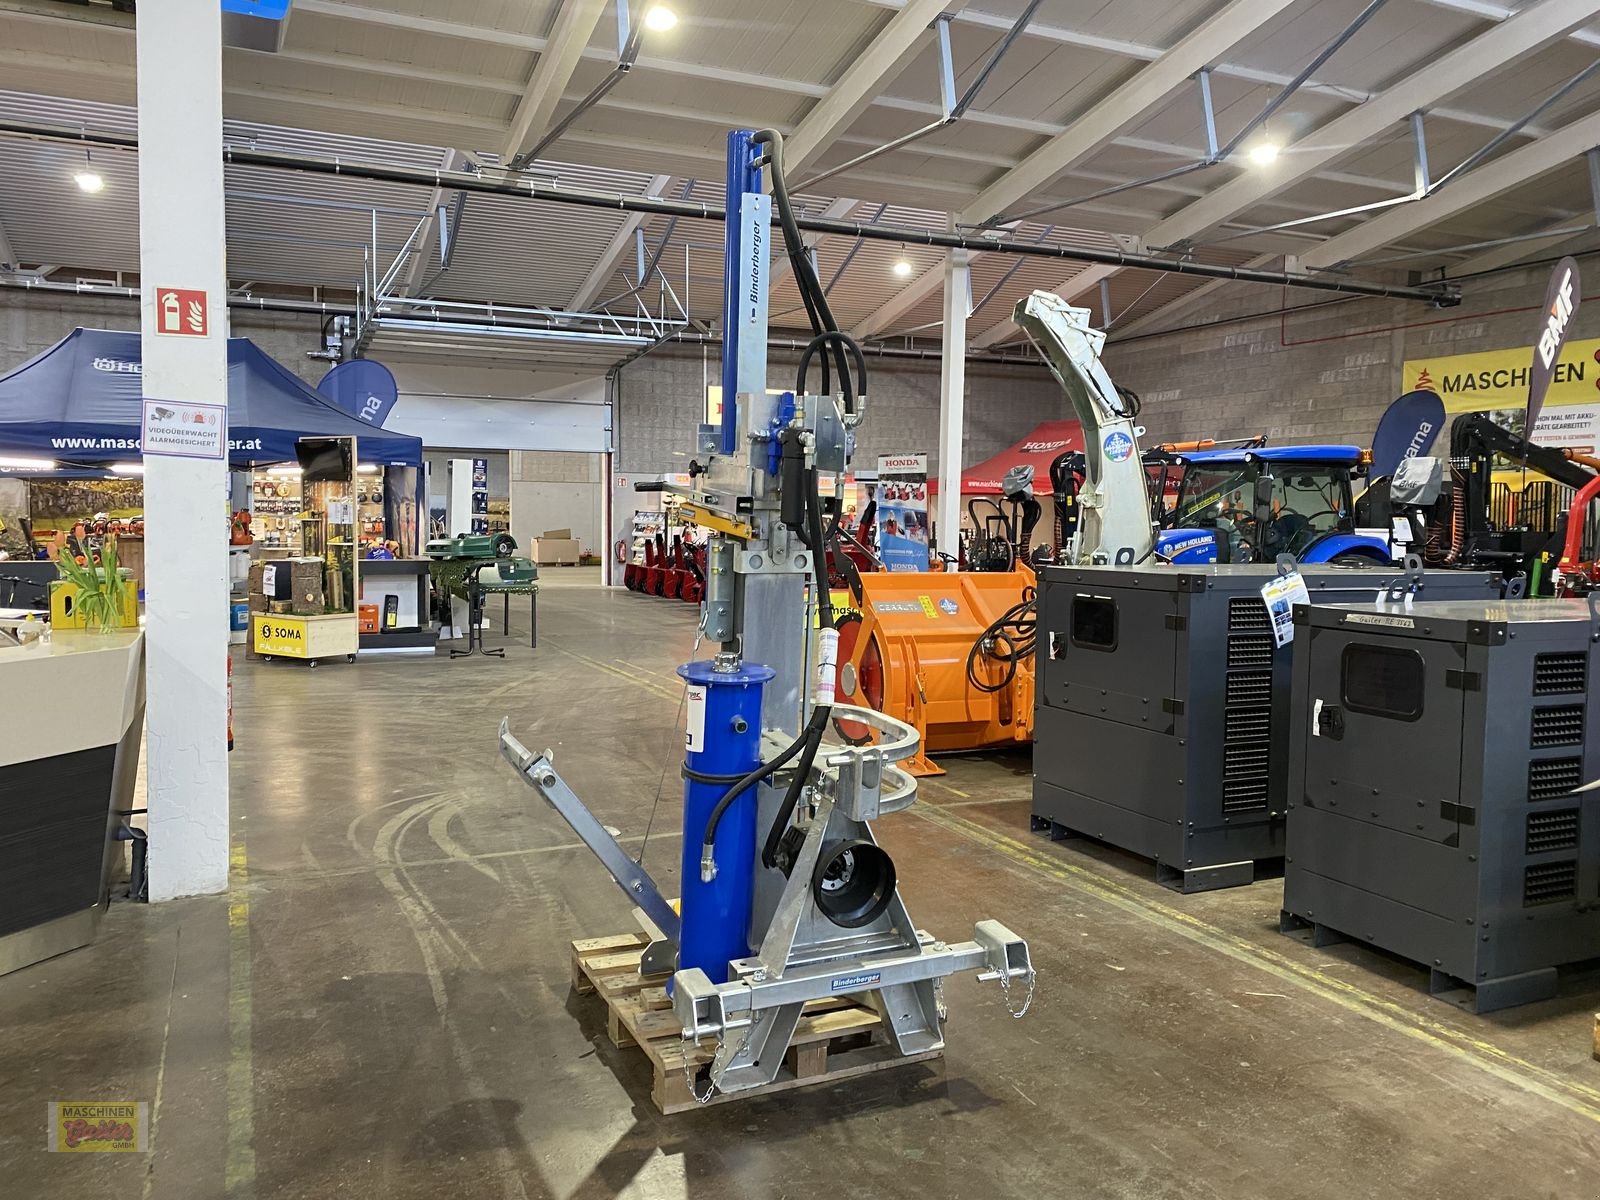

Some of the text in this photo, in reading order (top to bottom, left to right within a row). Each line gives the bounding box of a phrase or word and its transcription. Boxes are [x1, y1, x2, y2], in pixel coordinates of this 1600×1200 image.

[750, 219, 762, 304] Binderberger
[1539, 267, 1574, 370] BMF
[1443, 361, 1585, 393] MASCHIEN
[148, 426, 218, 439] VIDEOÜBERWACHT
[150, 436, 216, 447] ALARMGESICHERT
[1021, 438, 1072, 450] HONDA
[885, 459, 920, 467] HONDA
[1174, 535, 1213, 551] NEW HOLLAND
[275, 627, 302, 640] SOMA
[833, 974, 880, 987] Binderberger
